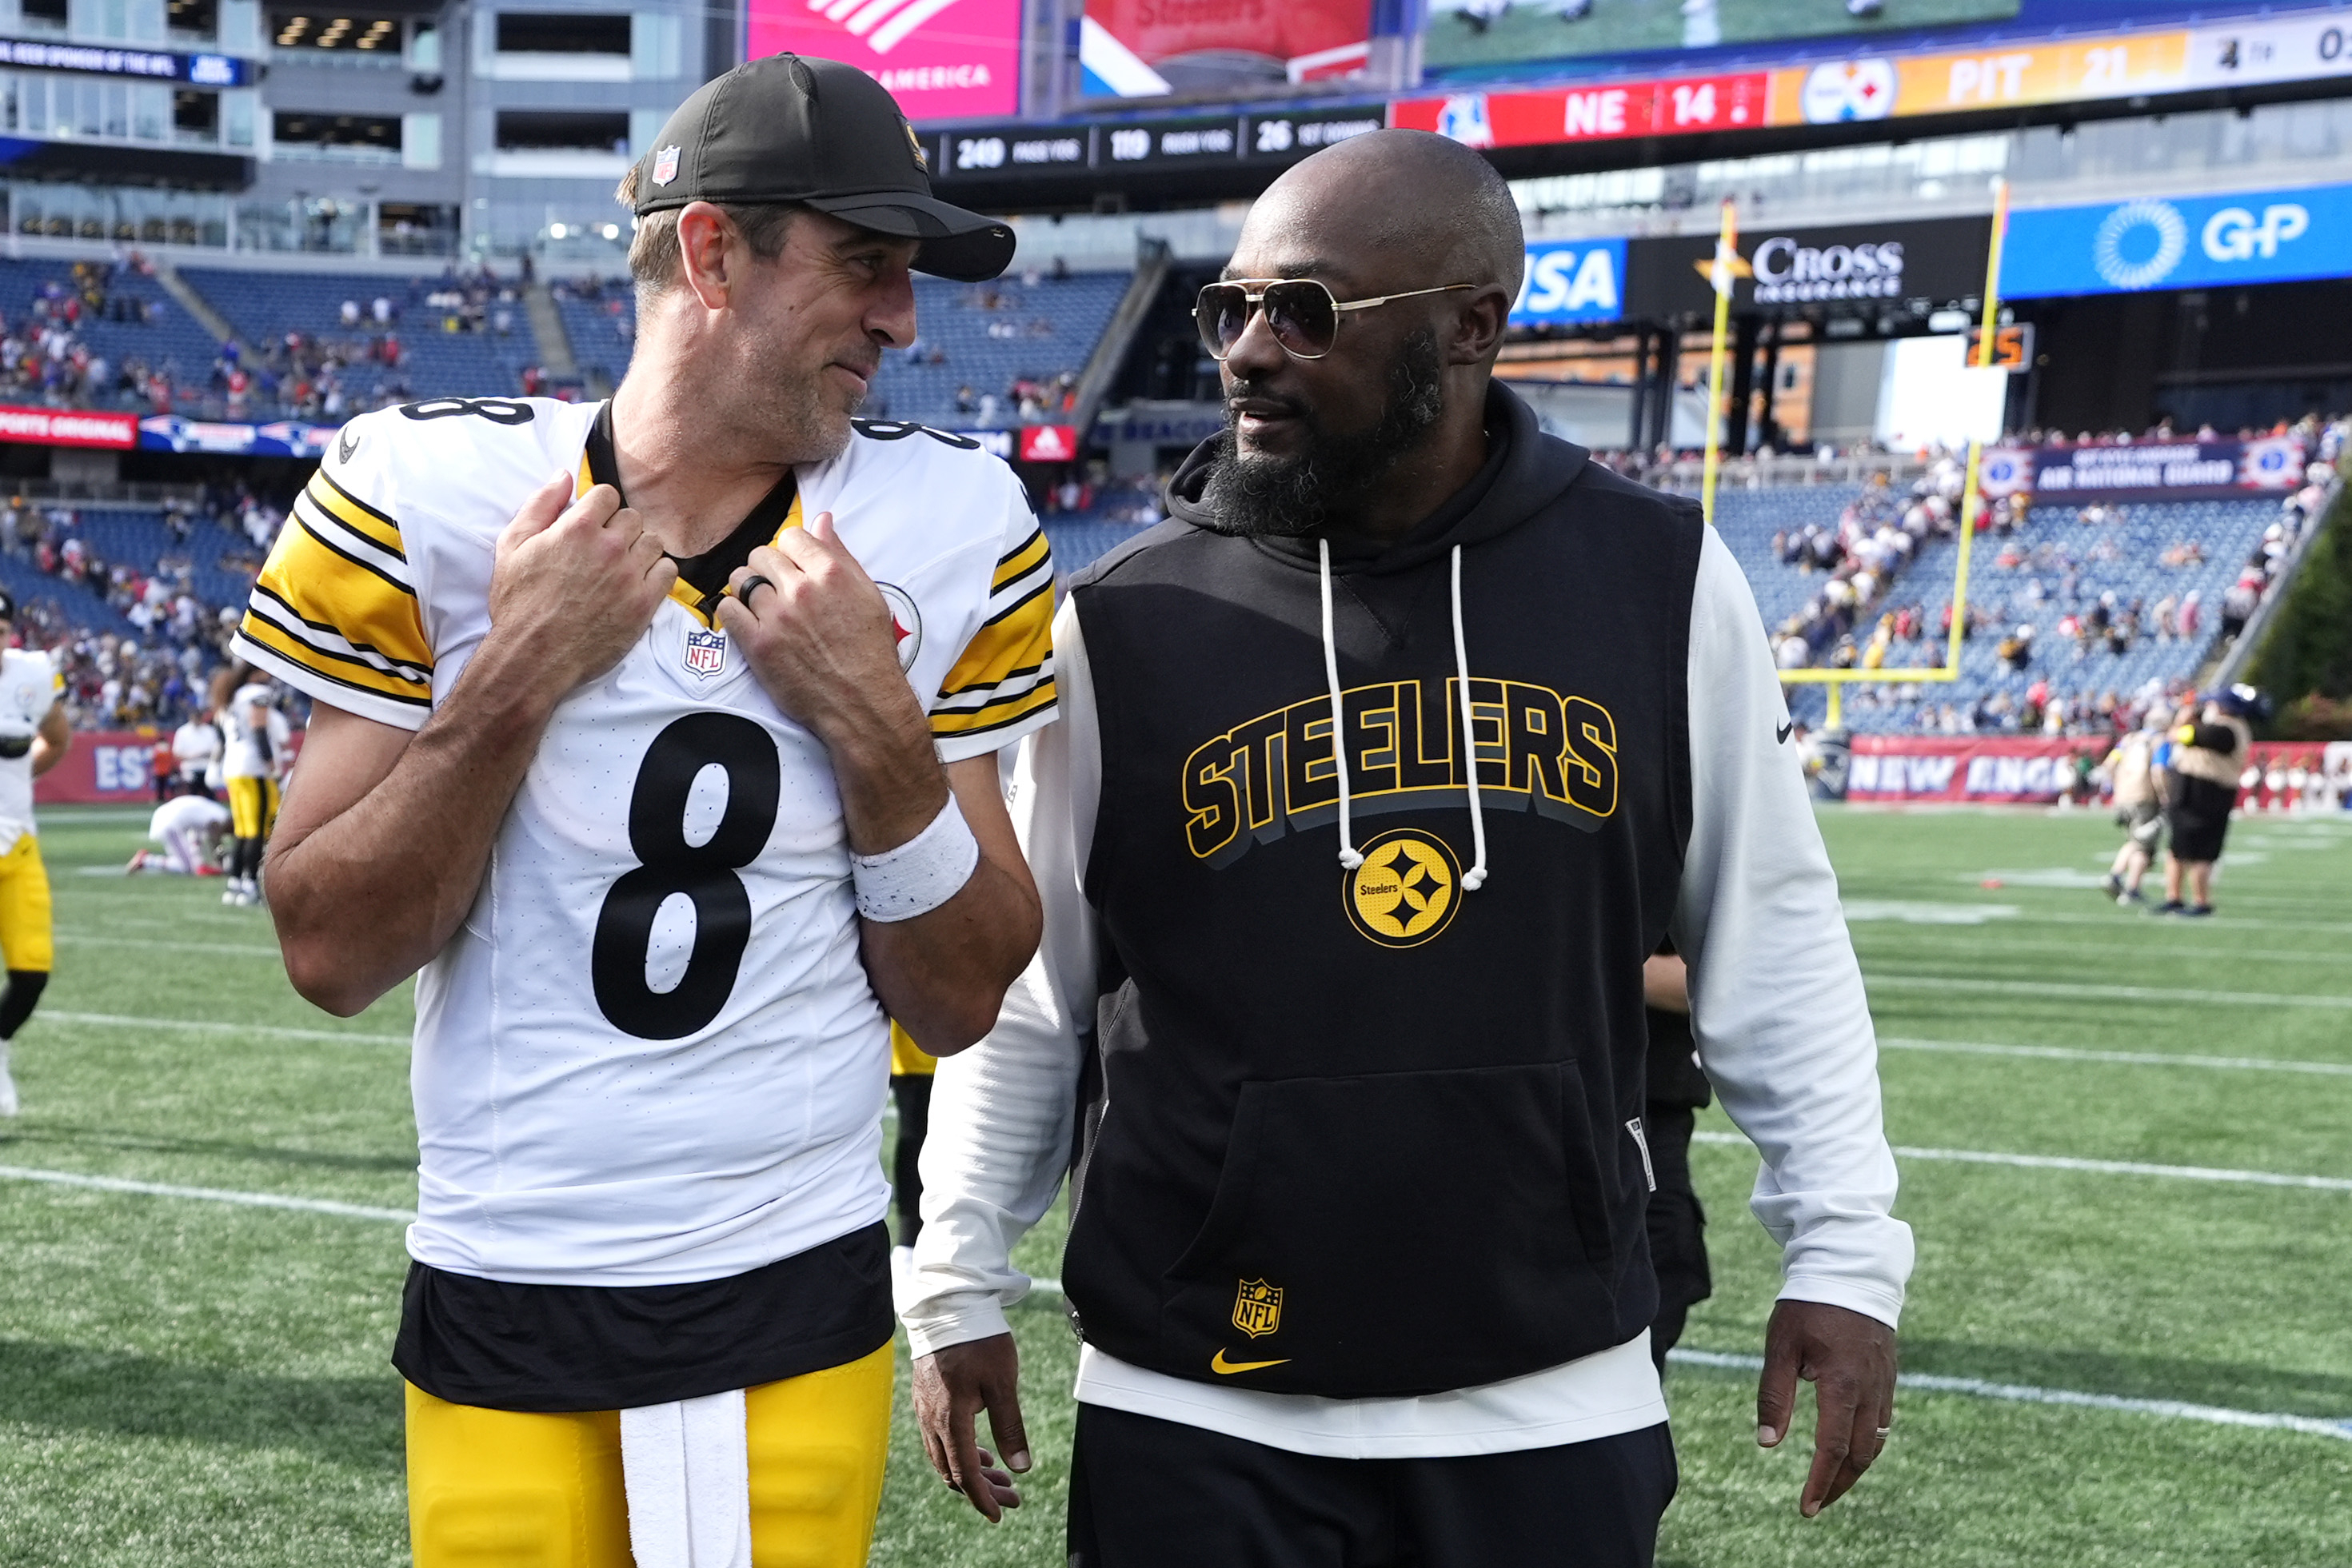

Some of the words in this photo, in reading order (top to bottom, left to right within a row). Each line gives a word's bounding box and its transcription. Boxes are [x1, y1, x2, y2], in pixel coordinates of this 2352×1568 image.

[881, 64, 992, 91] AMERICA
[1948, 54, 2033, 103] PIT
[2082, 46, 2128, 90] 21
[1564, 90, 1628, 136] NE
[1672, 83, 1717, 126] 14
[957, 137, 1005, 170] 249
[1256, 120, 1293, 152] 26
[2201, 203, 2310, 262] GP
[689, 647, 719, 670] NFL
[1183, 677, 1618, 860] STEELERS
[1847, 755, 1958, 792] NEW
[592, 712, 781, 1039] 8
[1360, 883, 1398, 896] Steelers
[1238, 1300, 1273, 1329] NFL
